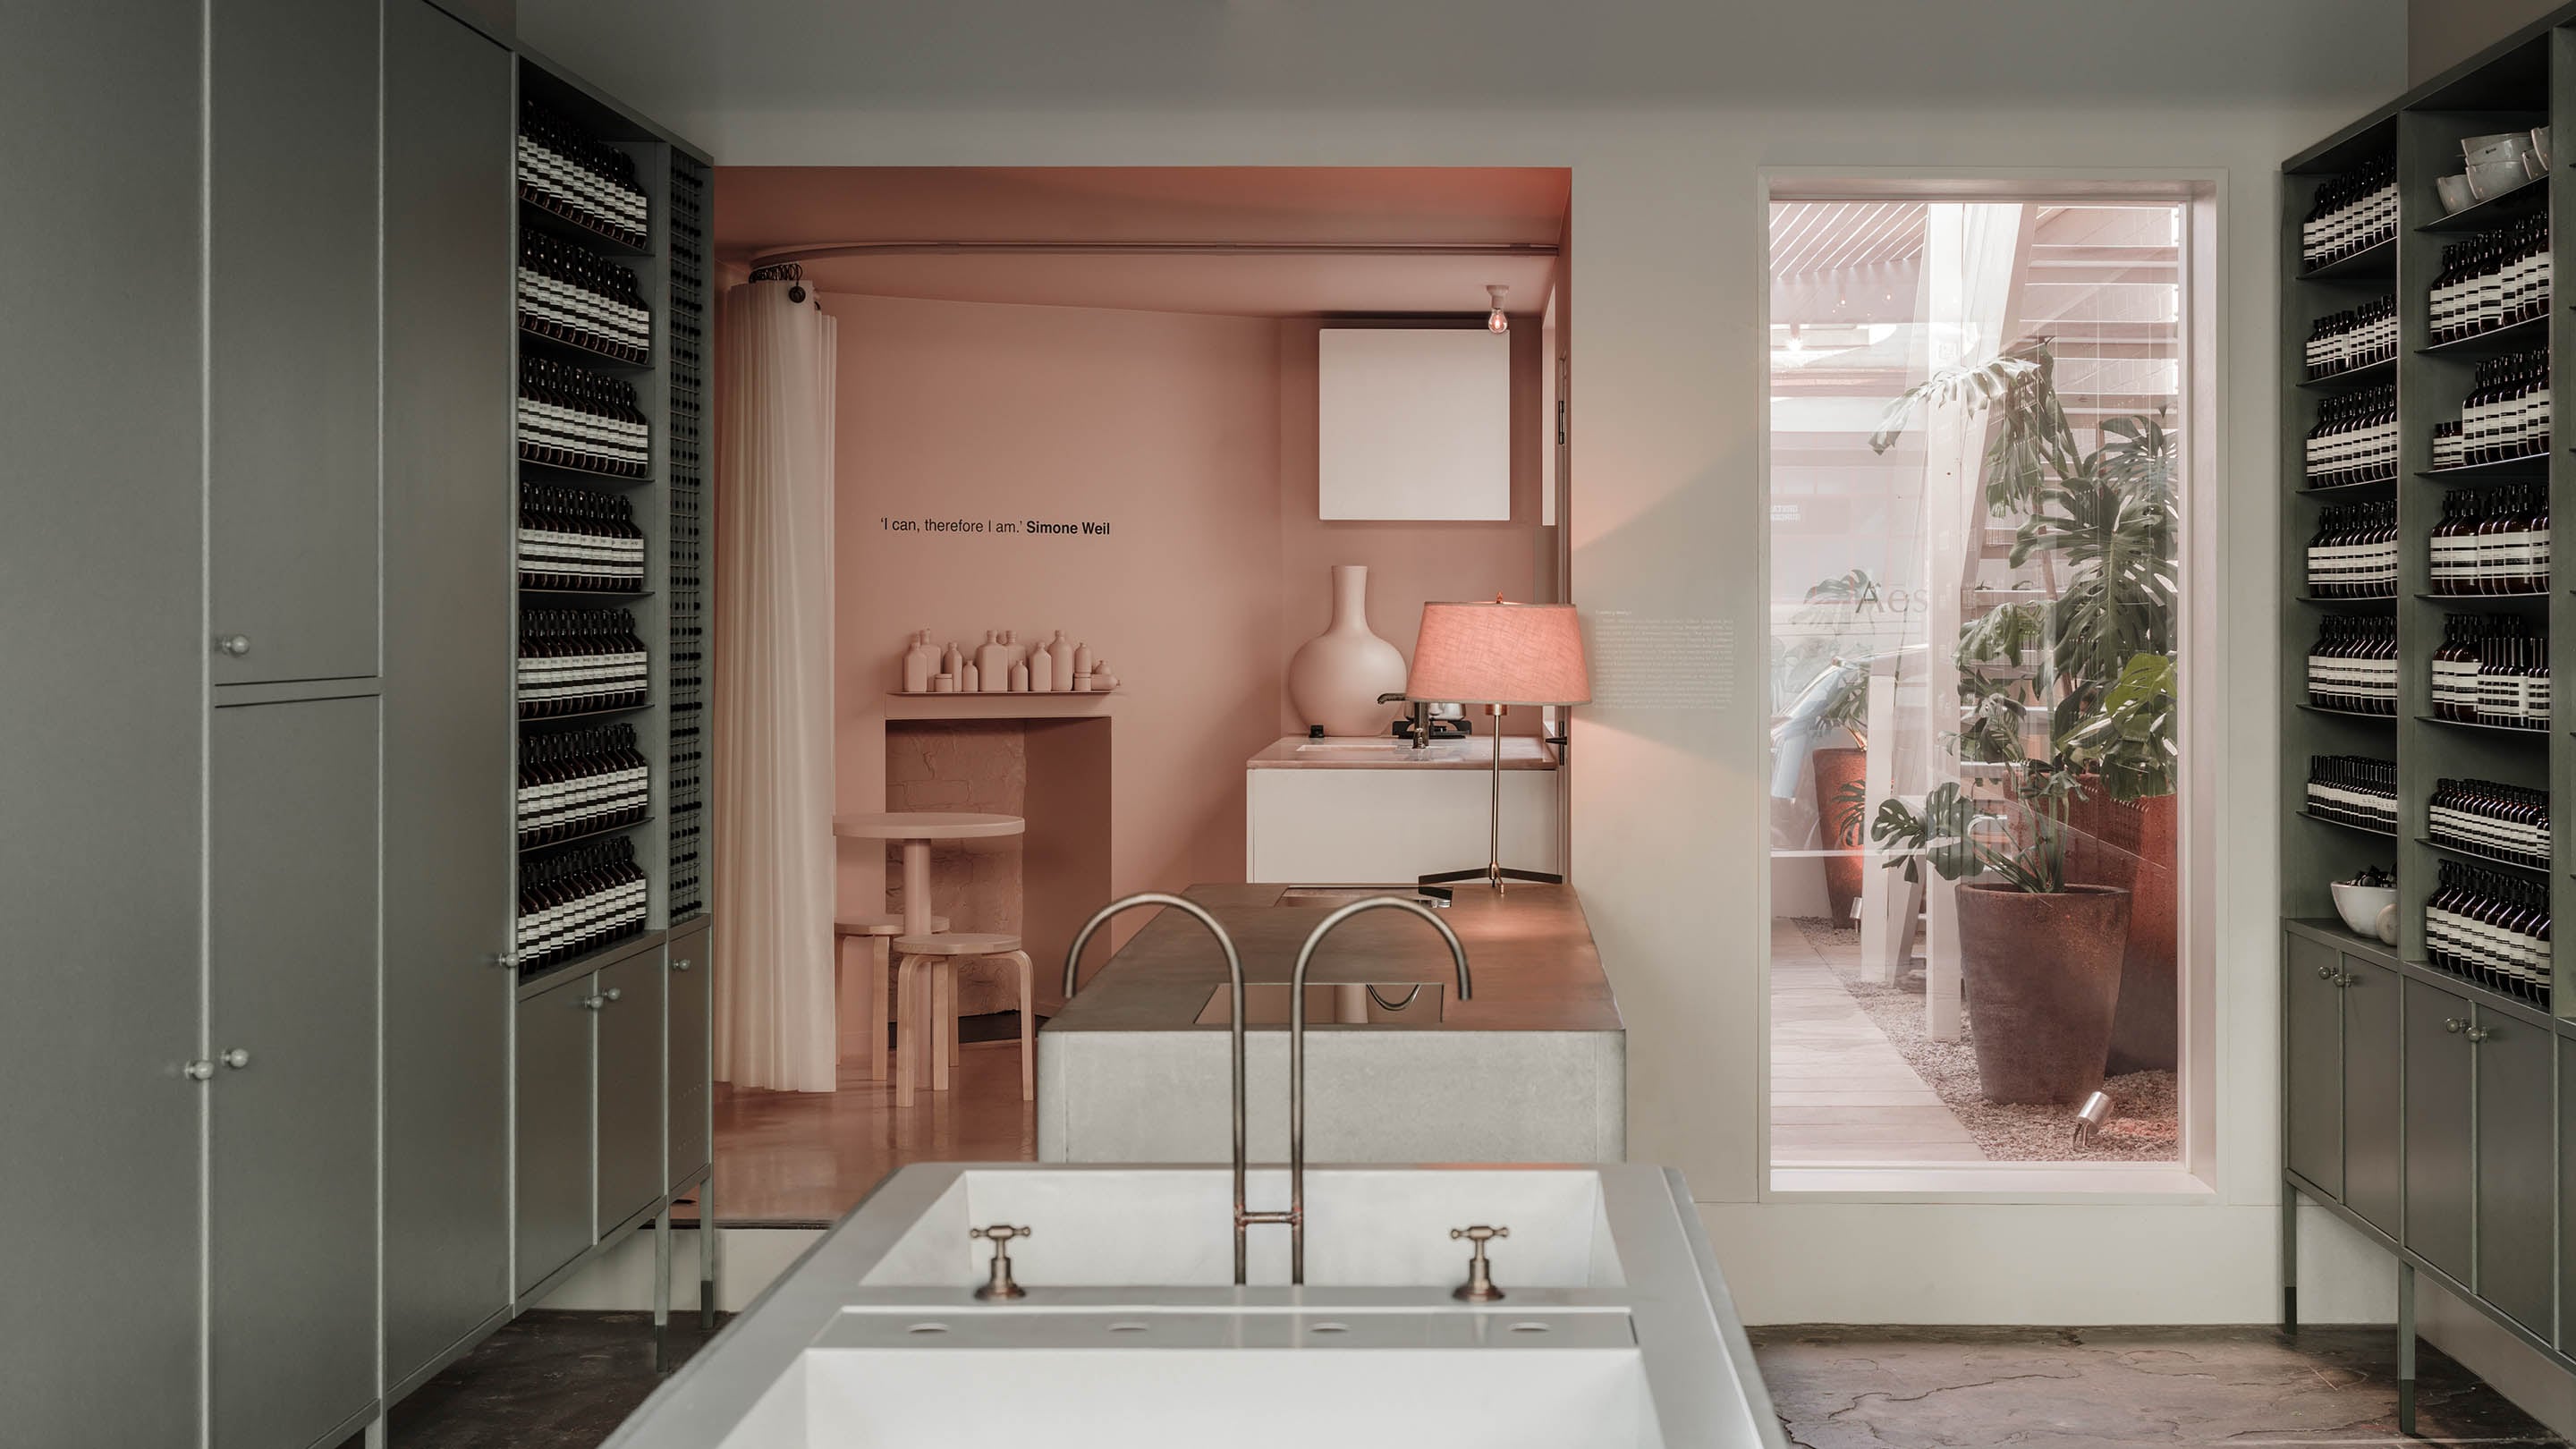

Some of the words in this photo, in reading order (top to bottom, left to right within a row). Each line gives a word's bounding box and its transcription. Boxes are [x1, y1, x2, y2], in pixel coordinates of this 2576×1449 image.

[892, 521, 920, 533] can,
[924, 519, 984, 533] therefore
[987, 520, 992, 533] I
[1026, 521, 1079, 534] Simone
[1081, 521, 1110, 535] Weil
